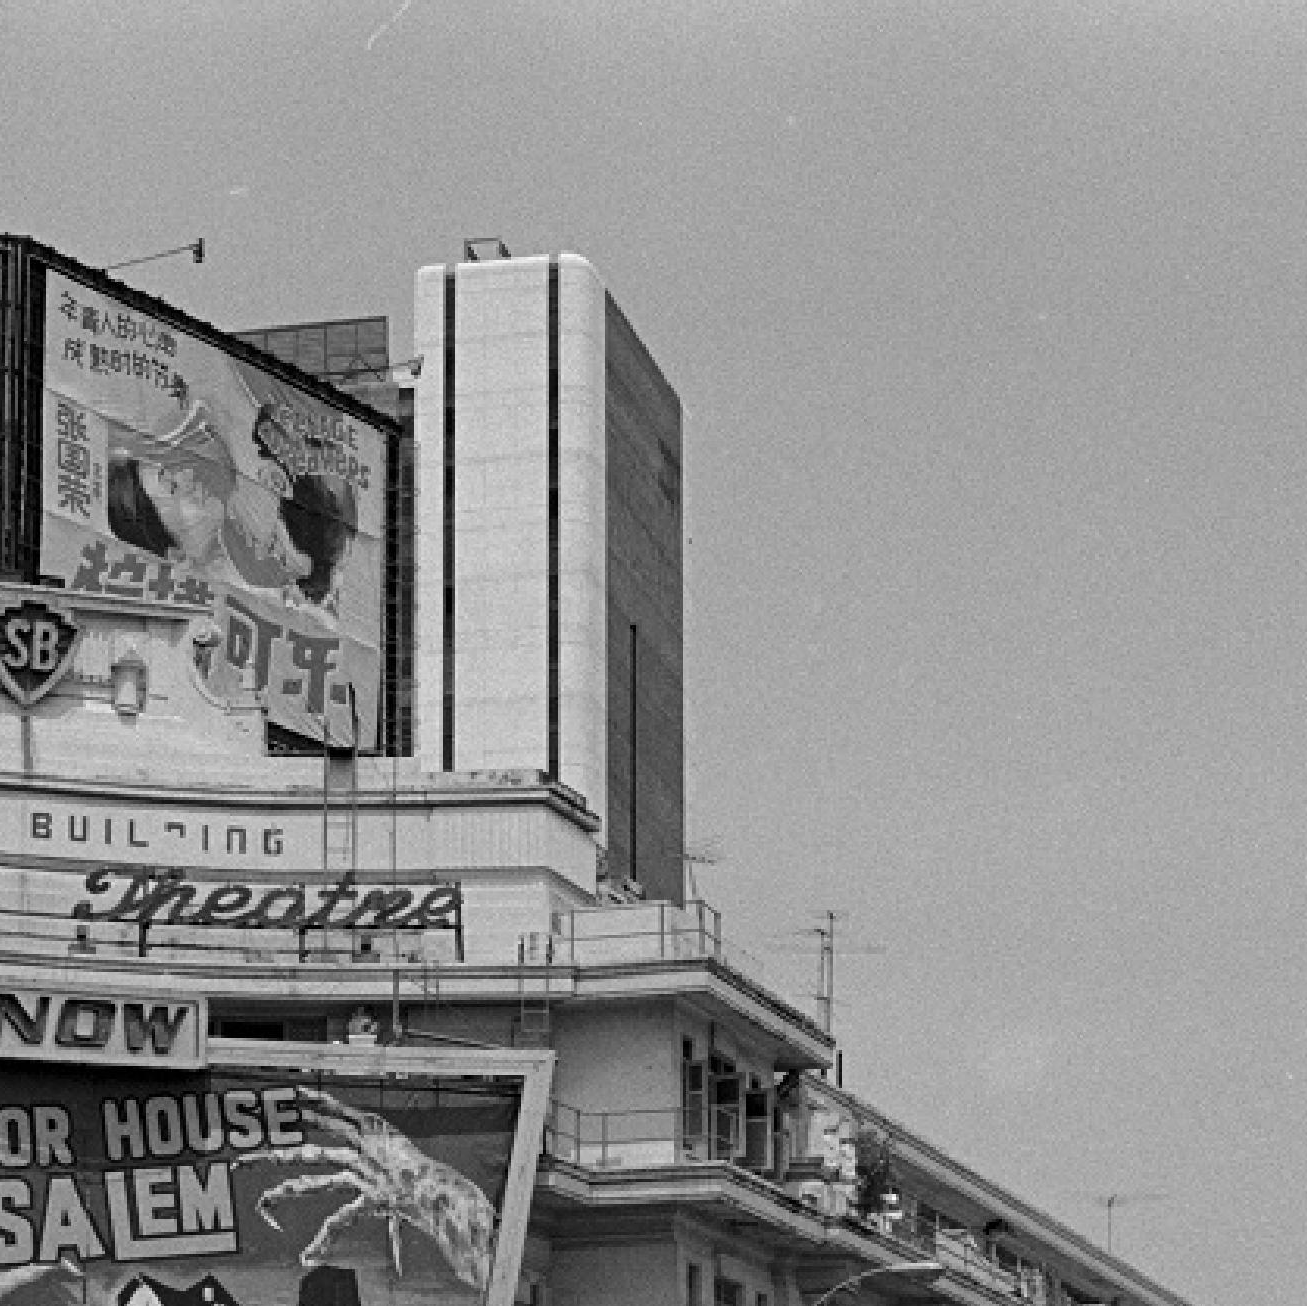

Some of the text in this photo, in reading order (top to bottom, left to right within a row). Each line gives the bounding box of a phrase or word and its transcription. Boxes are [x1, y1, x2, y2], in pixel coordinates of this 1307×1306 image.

[4, 618, 58, 670] SB
[71, 865, 462, 929] Theatre
[103, 1087, 304, 1160] HOUSE
